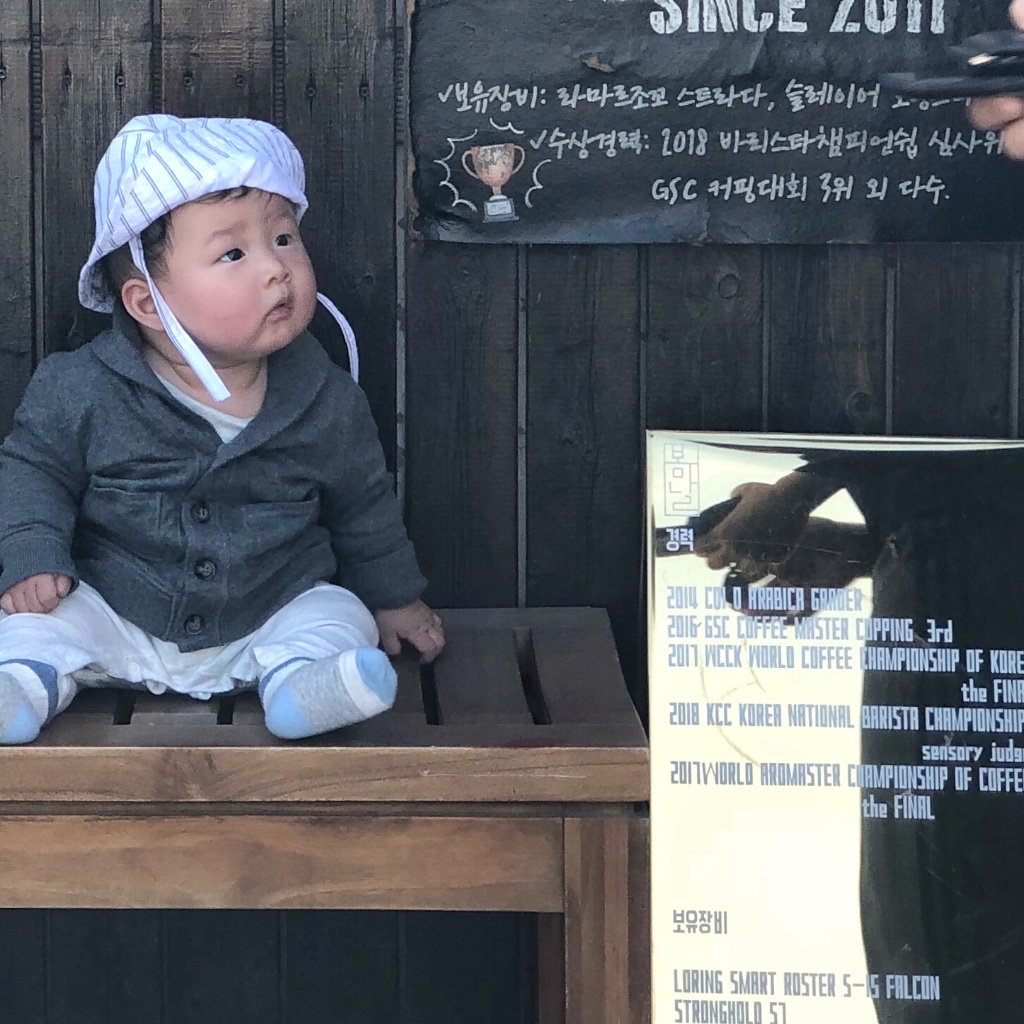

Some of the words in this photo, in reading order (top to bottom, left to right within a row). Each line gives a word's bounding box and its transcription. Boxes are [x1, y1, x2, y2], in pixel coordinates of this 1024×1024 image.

[661, 127, 708, 156] 2018
[651, 176, 697, 205] GSC
[866, 176, 889, 201] 외
[666, 528, 694, 552] 경력
[667, 586, 698, 609] 2014
[748, 587, 804, 611] ARABICA
[811, 587, 863, 611] GRADER
[667, 615, 698, 638] 2016
[737, 616, 788, 640] COFFEE
[794, 617, 849, 640] MASTER
[856, 618, 914, 642] CUPPING
[926, 618, 954, 643] 3rd
[668, 643, 698, 668] 2017
[705, 644, 743, 668] WCCK
[749, 645, 795, 669] WORLD
[801, 645, 853, 670] COFFEE
[860, 646, 960, 673] CHAMPIONSHIP
[966, 649, 984, 673] OF
[961, 678, 988, 703] the
[669, 702, 700, 726] 2018
[706, 702, 732, 726] KCC
[739, 703, 782, 727] KOREA
[788, 704, 855, 728] NATIONAL
[861, 705, 919, 731] BARISTA
[925, 707, 1024, 734] CHAMPIONSHIP
[922, 745, 983, 762] sensory
[990, 739, 1024, 763] judg
[760, 762, 841, 787] AROMASTER
[848, 764, 949, 791] CHAMPIONSHIP
[955, 766, 972, 791] OF
[979, 767, 1024, 793] COFFE
[862, 794, 888, 818] the
[894, 794, 936, 820] FINAL
[672, 909, 728, 934] 보유장비
[673, 969, 723, 995] LORING
[730, 970, 777, 996] SMART
[783, 972, 836, 998] ROSTER
[886, 974, 941, 1001] FALCON
[674, 999, 762, 1024] STRONGHOLD
